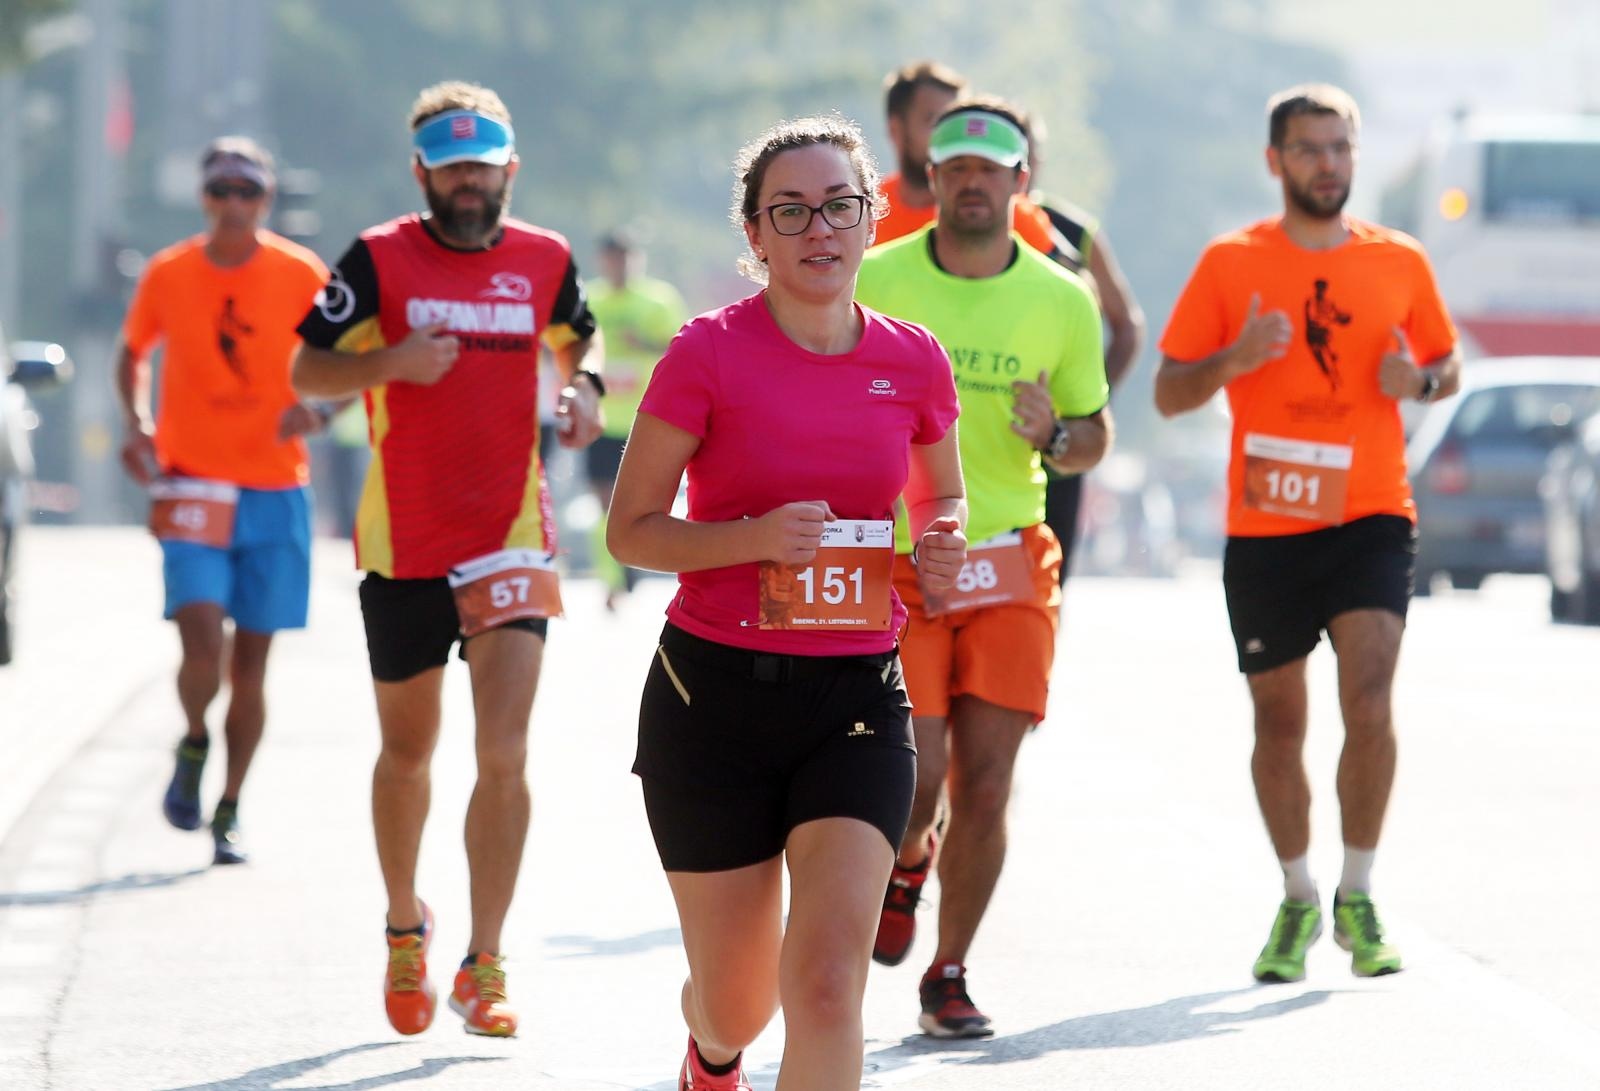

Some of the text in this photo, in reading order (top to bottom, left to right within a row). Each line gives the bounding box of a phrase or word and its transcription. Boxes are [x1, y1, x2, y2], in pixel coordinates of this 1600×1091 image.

[406, 297, 482, 333] OCEAN
[951, 348, 1021, 377] VE TO
[1266, 469, 1321, 506] 101
[490, 575, 531, 609] 57
[796, 566, 863, 605] 151
